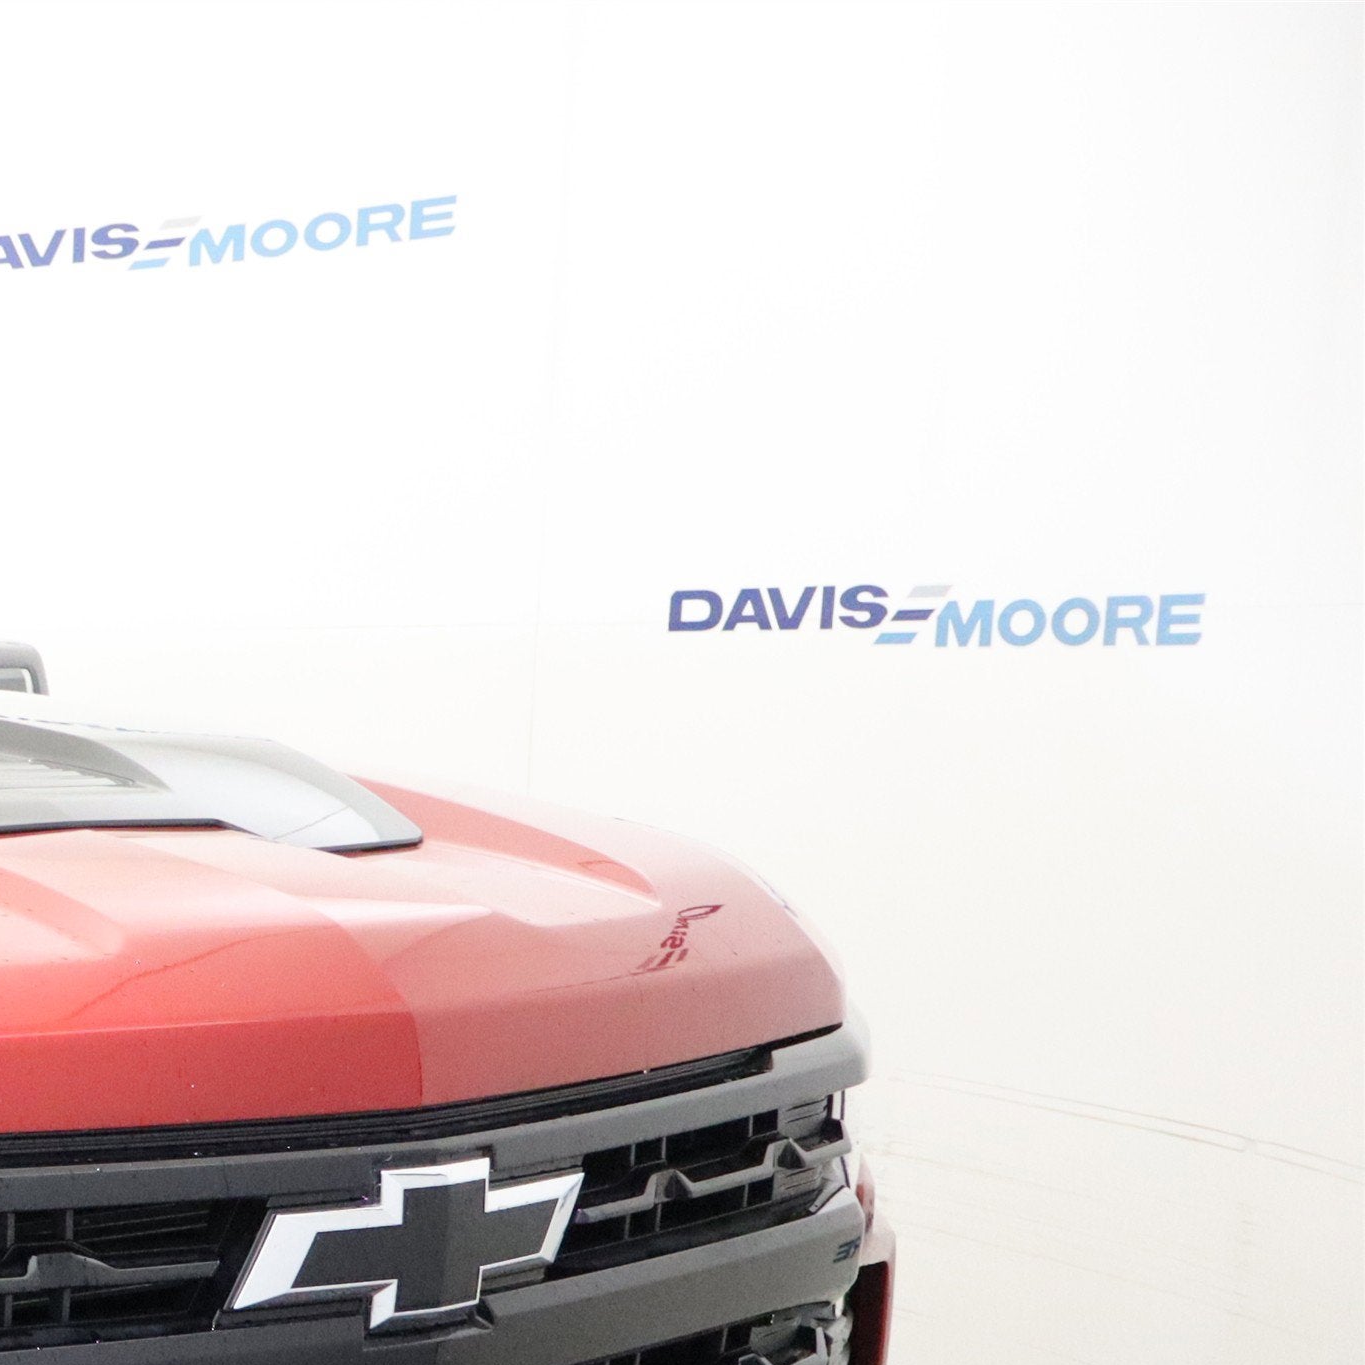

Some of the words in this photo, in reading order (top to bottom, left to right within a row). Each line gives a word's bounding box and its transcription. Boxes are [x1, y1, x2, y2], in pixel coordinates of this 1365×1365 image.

[188, 194, 458, 268] MOORE
[668, 584, 889, 632] DAVIS
[934, 592, 1206, 648] MOORE
